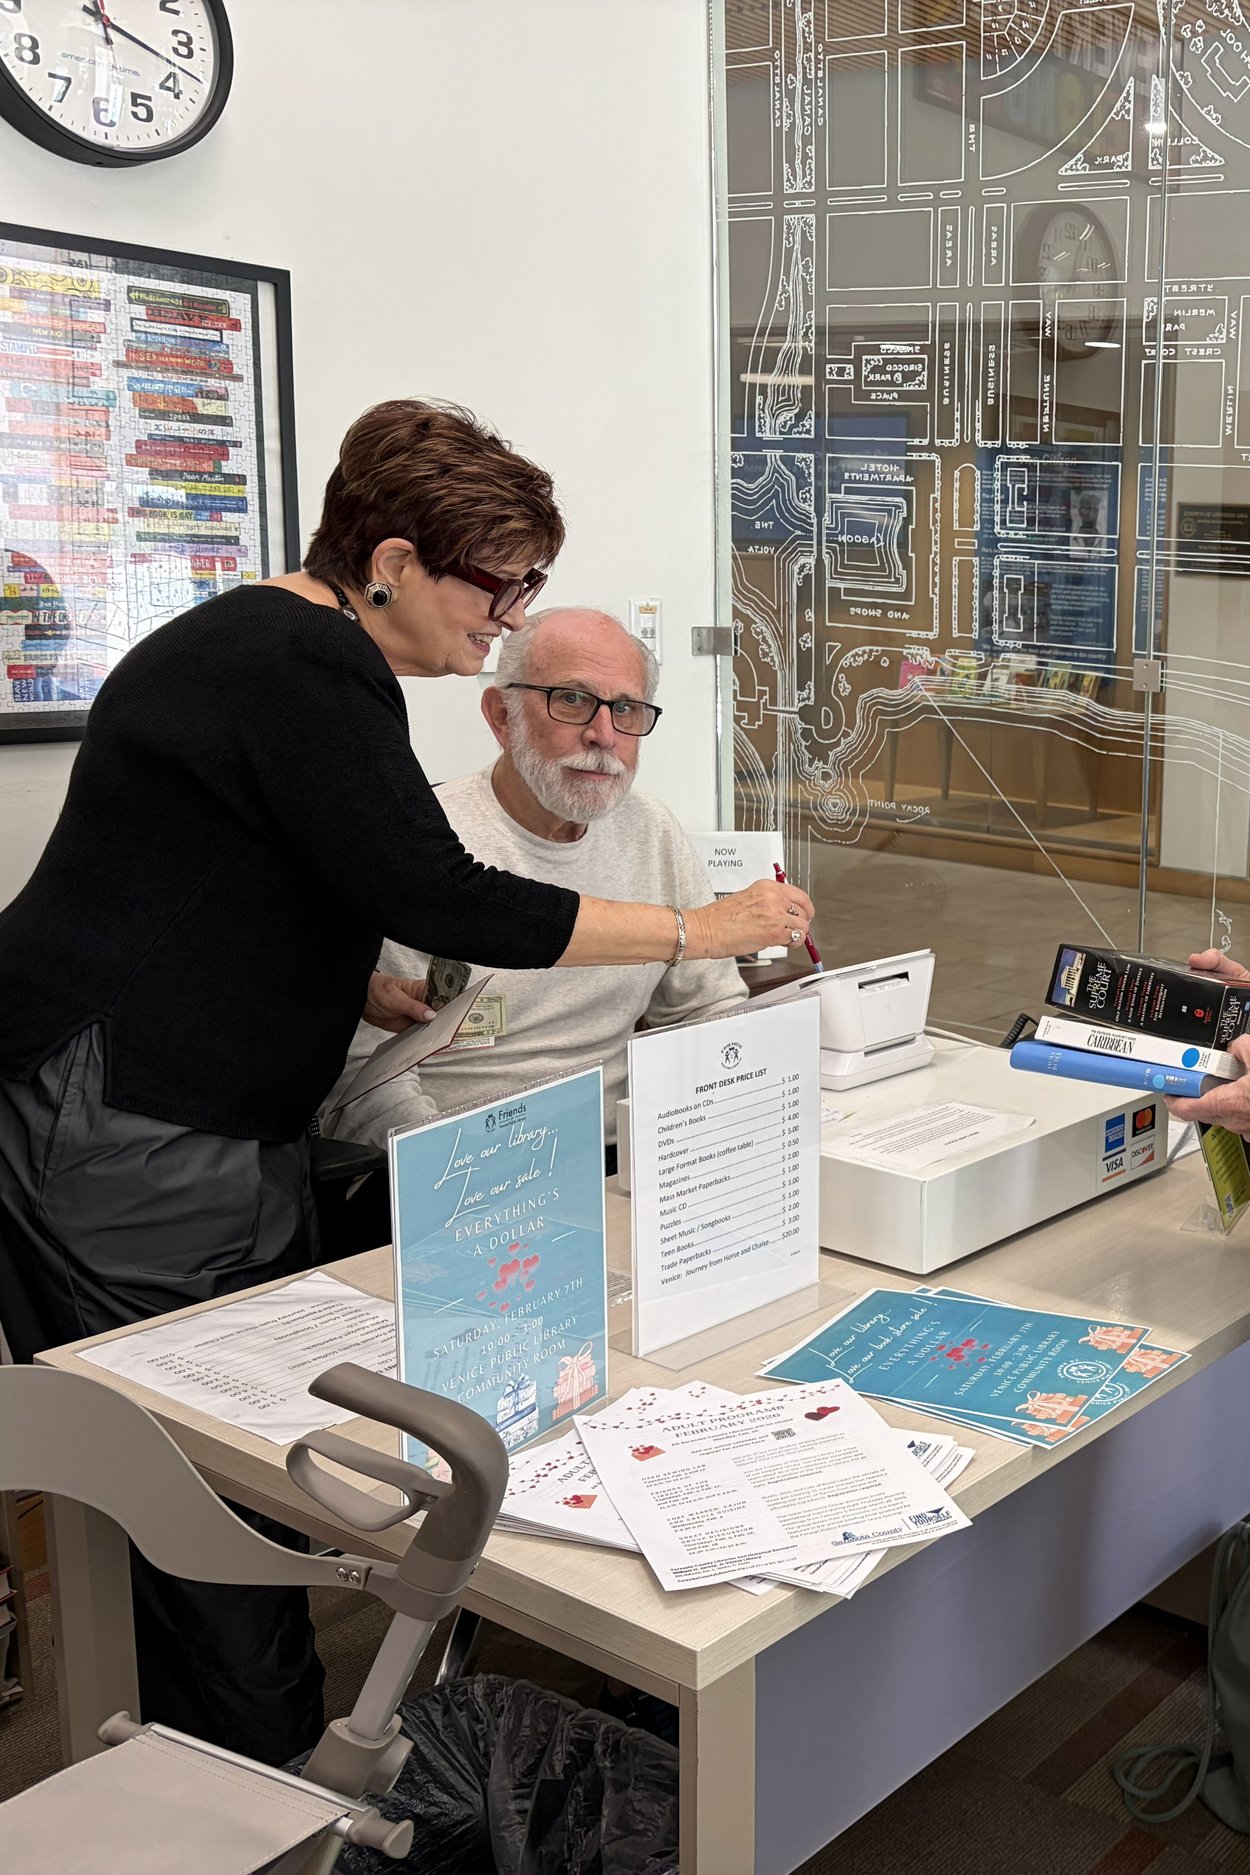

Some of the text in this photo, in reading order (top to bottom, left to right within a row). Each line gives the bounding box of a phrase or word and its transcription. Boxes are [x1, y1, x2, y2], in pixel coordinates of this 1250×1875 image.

[14, 33, 41, 66] 8
[171, 29, 194, 60] 3
[48, 72, 72, 104] 7
[159, 72, 183, 100] 4
[130, 92, 154, 123] 5
[708, 859, 743, 868] PLAYING
[714, 848, 737, 856] NOW
[1089, 962, 1107, 1009] SUPREME
[1096, 967, 1112, 1009] COURT
[1086, 1034, 1136, 1054] CARIBBEAN
[695, 1067, 768, 1095] FRONT DESK PRICE LIST
[498, 1102, 527, 1121] Friends
[657, 1098, 714, 1120] Audiobooks on CDs
[657, 1114, 707, 1134] Children's Books
[657, 1138, 675, 1148] DVDs
[658, 1111, 800, 1162] Hardcover 4.00
[658, 1124, 800, 1177] Large Format Books (coffee table) 5.00
[1131, 1142, 1154, 1159] DISCOVER
[434, 1128, 480, 1189] Love
[480, 1143, 501, 1158] our
[658, 1137, 800, 1190] Magazines 0.50
[1105, 1156, 1124, 1174] VISA
[444, 1157, 541, 1228] Love our sale
[659, 1150, 800, 1204] Mass Market Paperbacks 2.00
[454, 1187, 560, 1243] EVERYTHING'S
[659, 1202, 688, 1217] Music CD
[659, 1218, 682, 1231] Puzzles
[473, 1216, 545, 1257] A DOLLAR
[660, 1214, 732, 1245] Sheet Music Songbooks
[661, 1201, 800, 1259] Teen Books 2.00
[661, 1214, 800, 1272] Trade Paperbacks 3.00
[661, 1273, 683, 1286] Venice:
[684, 1263, 709, 1277] Journey
[708, 1256, 723, 1268] from
[723, 1250, 740, 1263] Horse
[740, 1247, 752, 1257] and
[751, 1238, 770, 1251] Chaise
[504, 1288, 560, 1325] FEBRUARY
[564, 1277, 584, 1297] 7TH
[480, 1316, 544, 1356] 10:00 3:00
[843, 1334, 856, 1347] our
[878, 1320, 941, 1371] EVERYTHING'S
[907, 1330, 951, 1366] A DOLLAR
[988, 1333, 1023, 1364] FEBRUARY
[1018, 1321, 1034, 1337] 7TH
[441, 1315, 578, 1393] VENICE PUBLIC LIBRARY
[862, 1350, 875, 1363] our
[989, 1330, 1061, 1398] VENICE PUBLIC LIBRARY
[993, 1344, 1030, 1376] 10:00 3:00
[1013, 1338, 1070, 1393] COMMUNITY ROOM
[457, 1340, 566, 1403] COMMUNITY ROOM
[661, 1405, 786, 1433] ADULT PROGRAMS
[674, 1419, 746, 1438] FEBRUARY
[871, 1526, 903, 1538] County
[908, 1511, 928, 1524] FIND
[911, 1509, 952, 1528] YOURSELF
